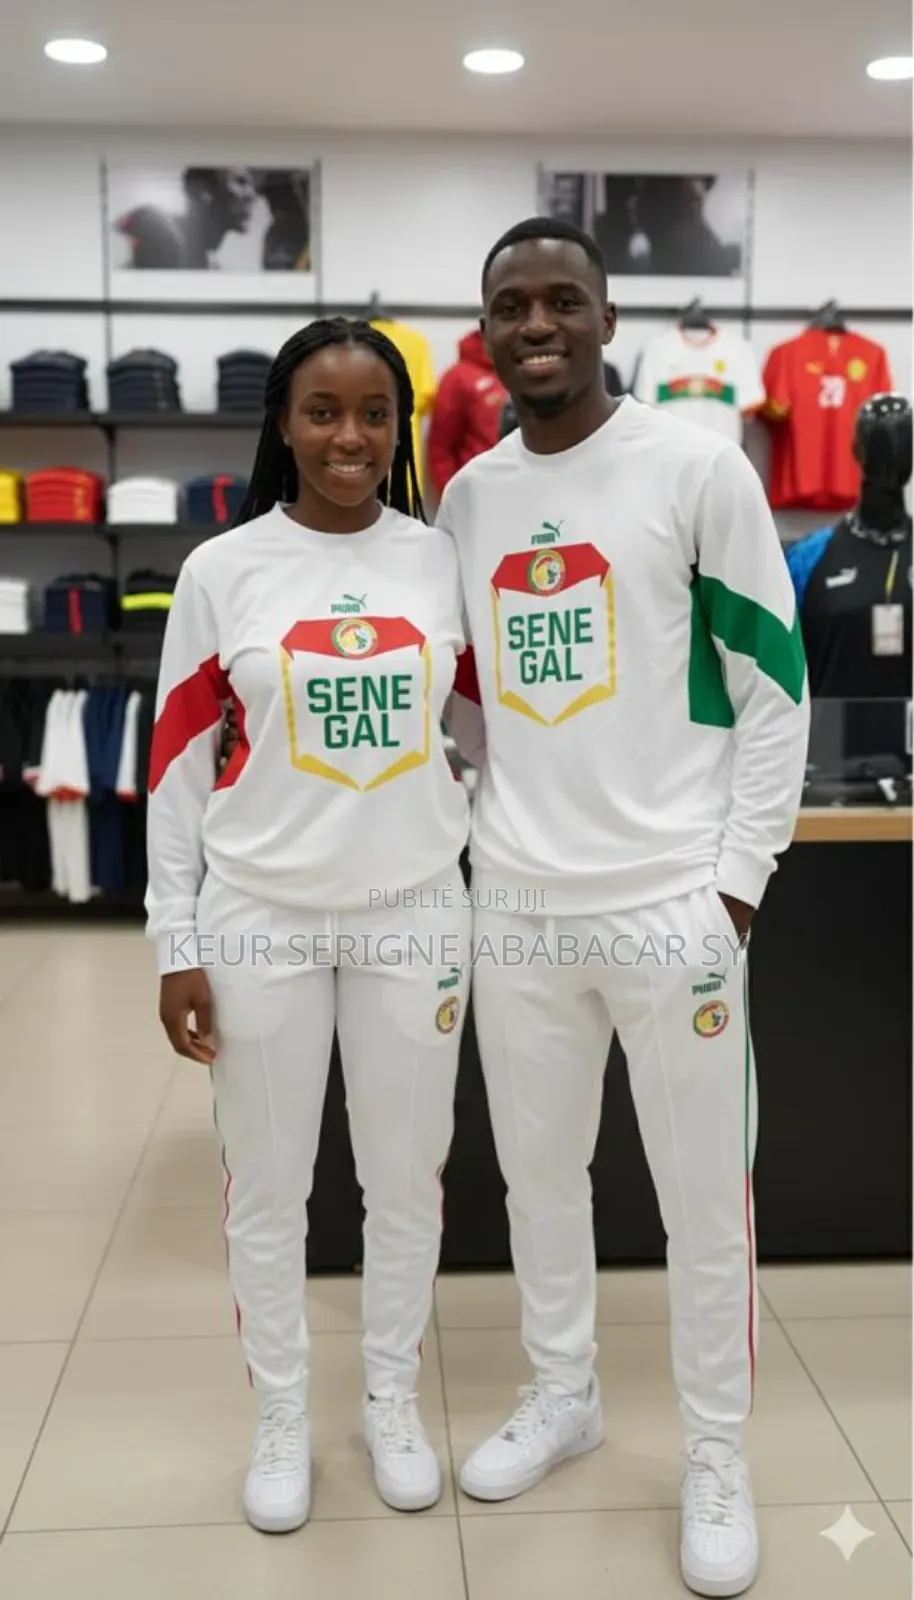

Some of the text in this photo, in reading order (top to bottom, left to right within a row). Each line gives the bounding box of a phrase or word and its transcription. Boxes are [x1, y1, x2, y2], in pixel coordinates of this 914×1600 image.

[507, 607, 593, 650] SENE
[520, 647, 583, 685] GAL
[306, 674, 413, 714] SENE
[324, 713, 400, 749] GAL
